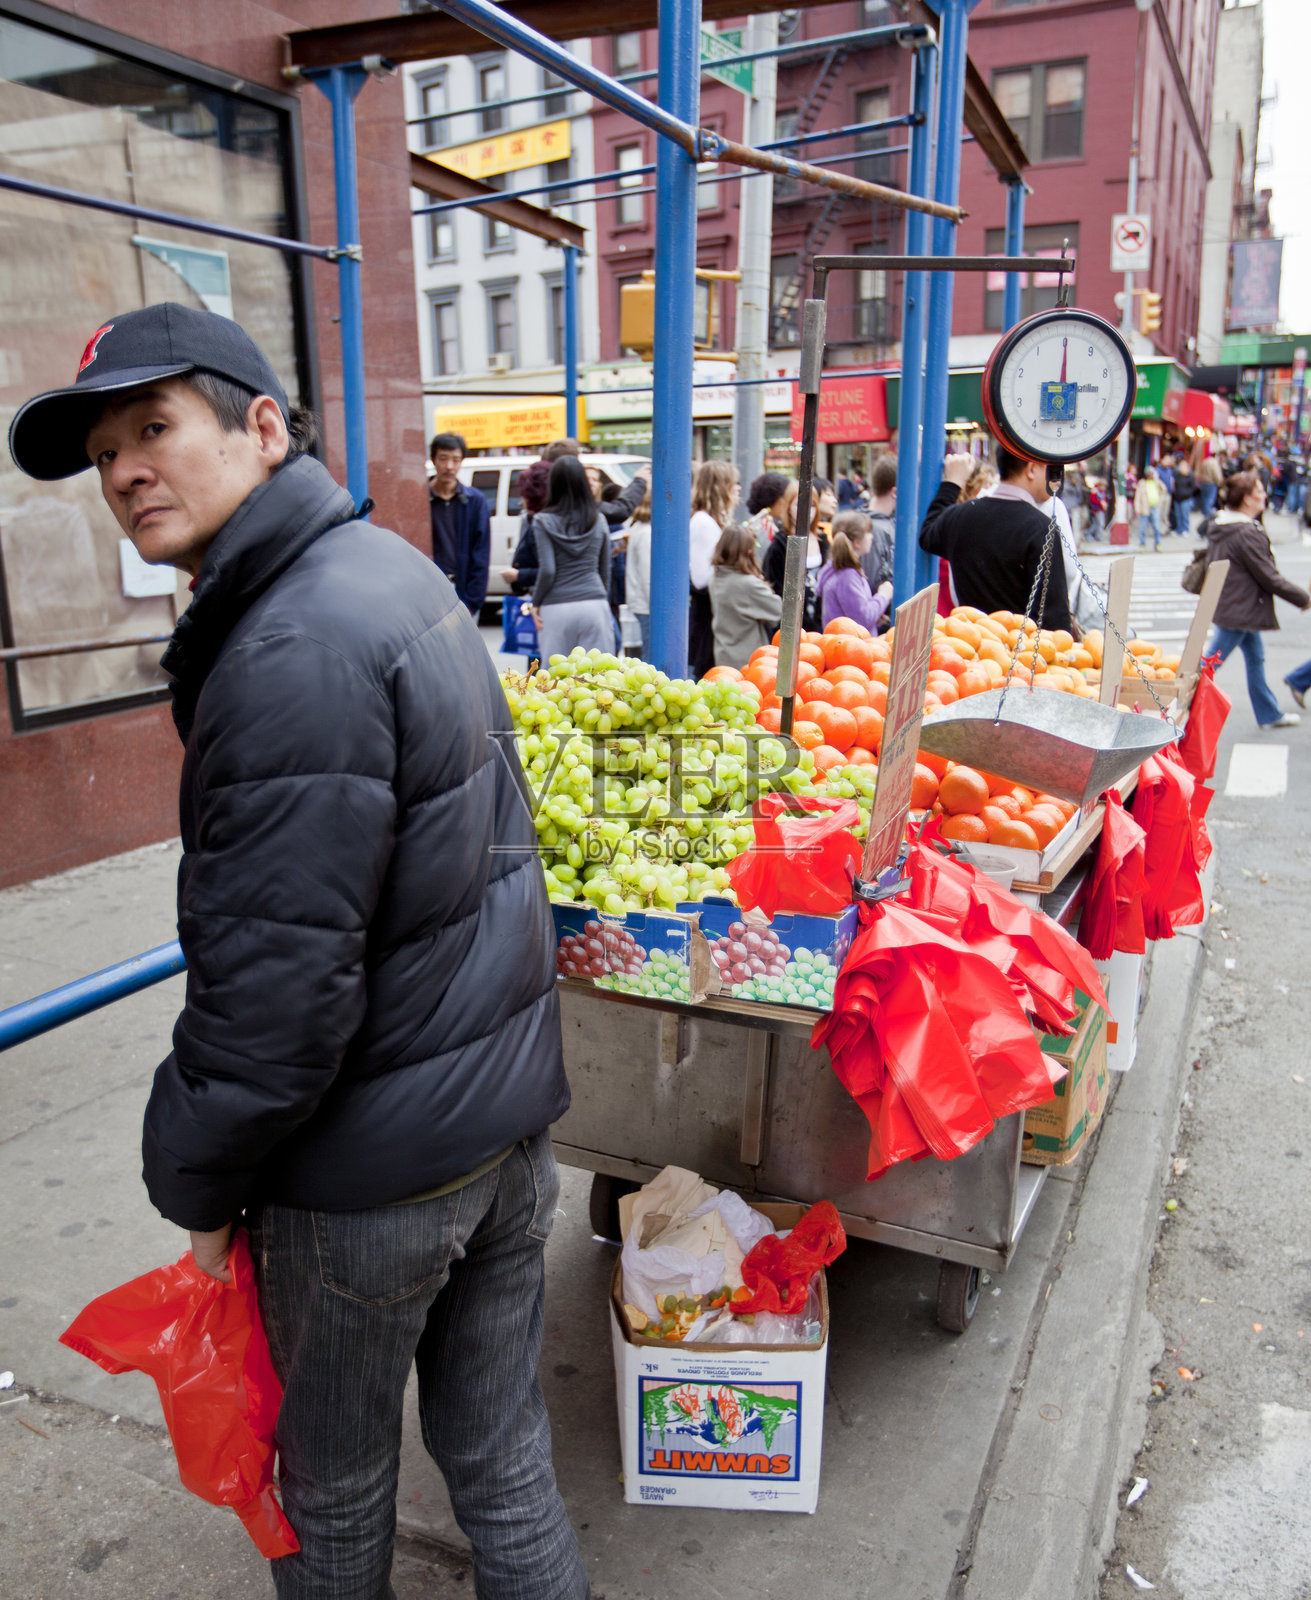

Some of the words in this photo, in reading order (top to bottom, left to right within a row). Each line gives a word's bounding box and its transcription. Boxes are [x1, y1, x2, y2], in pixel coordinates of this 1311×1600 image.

[1062, 337, 1068, 348] 0
[1088, 346, 1094, 357] 9
[1018, 367, 1024, 378] 2
[1102, 368, 1108, 378] 8
[797, 388, 865, 406] FRTUNE
[1017, 397, 1022, 408] 3
[1101, 398, 1107, 408] 7
[843, 409, 872, 425] INC.
[1031, 419, 1037, 430] 4
[1082, 419, 1088, 430] 6
[1056, 427, 1062, 438] 5
[649, 1449, 792, 1474] SUMMIT
[639, 1485, 677, 1495] ORANGES
[641, 1492, 664, 1501] NAVEL
